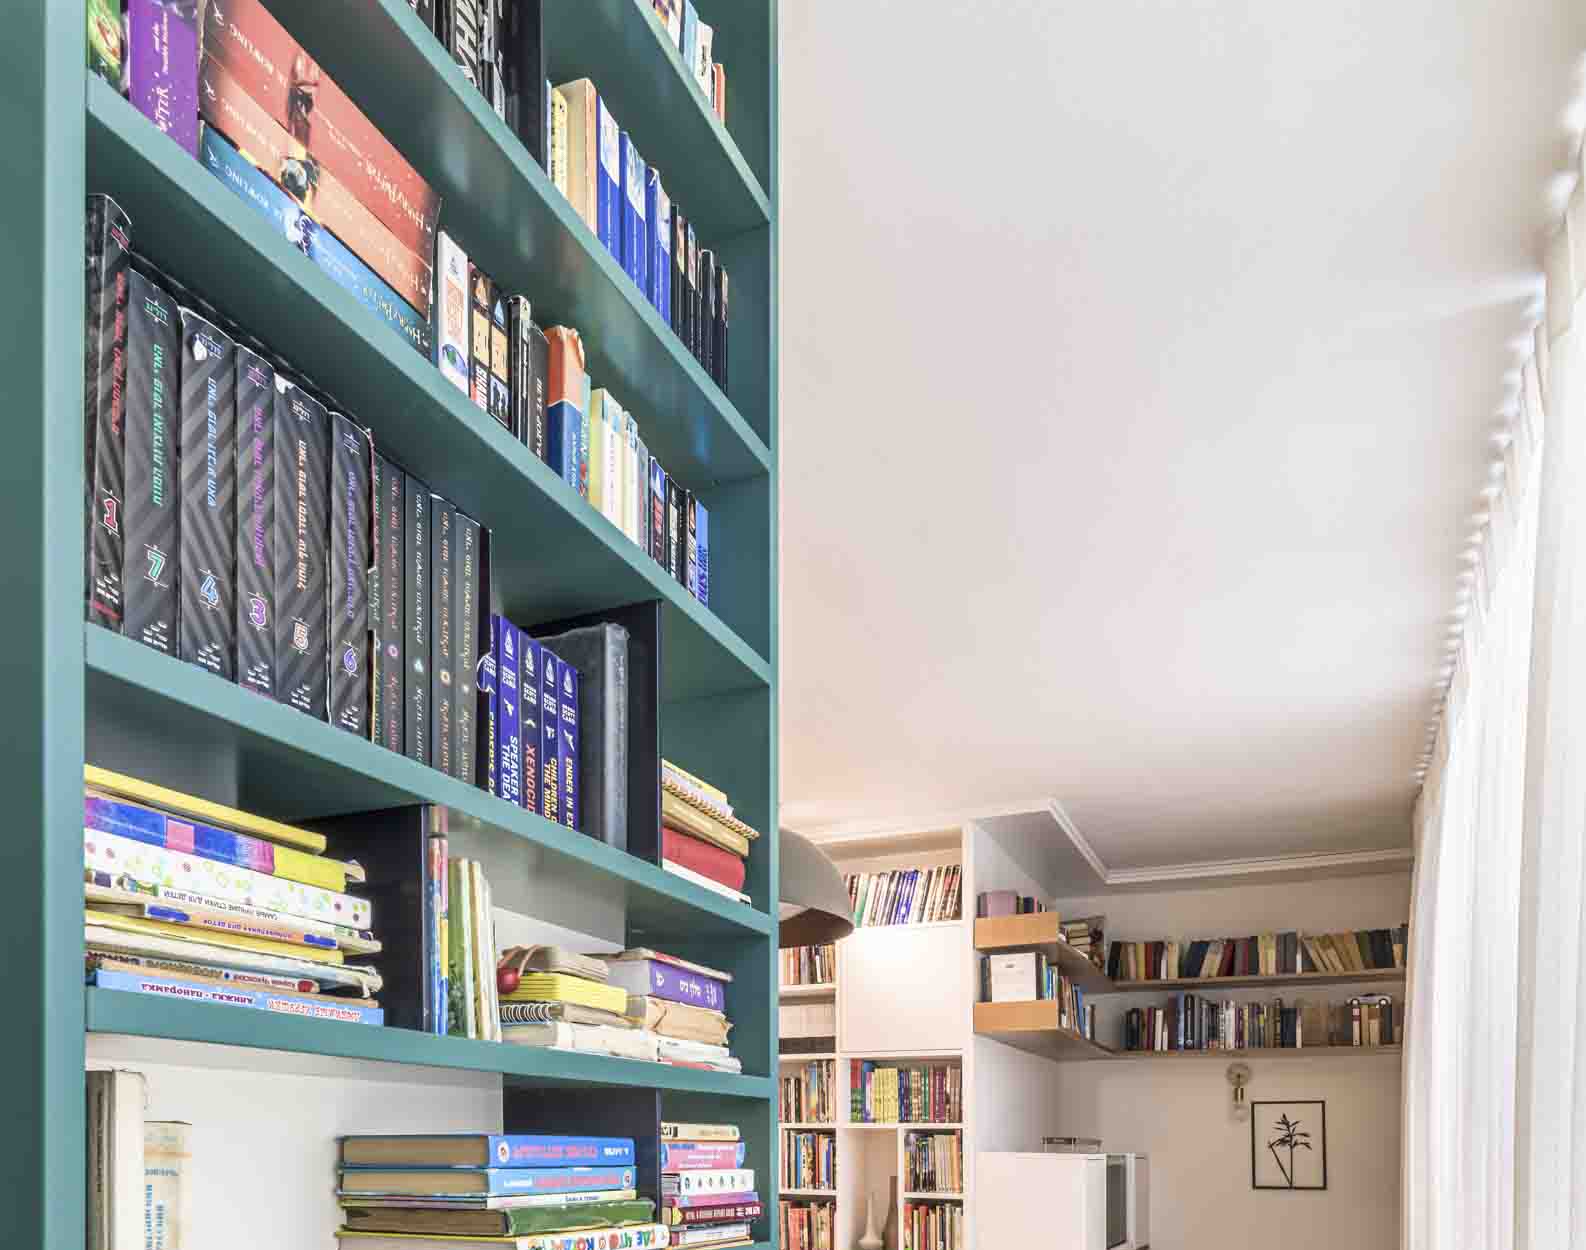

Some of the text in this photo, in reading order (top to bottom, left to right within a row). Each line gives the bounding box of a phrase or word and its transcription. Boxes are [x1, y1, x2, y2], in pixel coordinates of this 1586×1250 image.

[151, 341, 162, 376] הארי
[151, 375, 162, 408] פוטר
[206, 376, 216, 410] הארי
[206, 409, 216, 439] פוטר
[296, 438, 306, 470] הארי
[296, 469, 306, 501] פוטר
[503, 744, 511, 764] THE
[510, 735, 518, 794] SPEAKER
[549, 757, 557, 811] CHILDREN
[565, 757, 573, 801] ENDER IN
[542, 785, 551, 821] MIND
[141, 983, 254, 1004] книжка панорамка
[632, 1229, 655, 1248] ГДЕ
